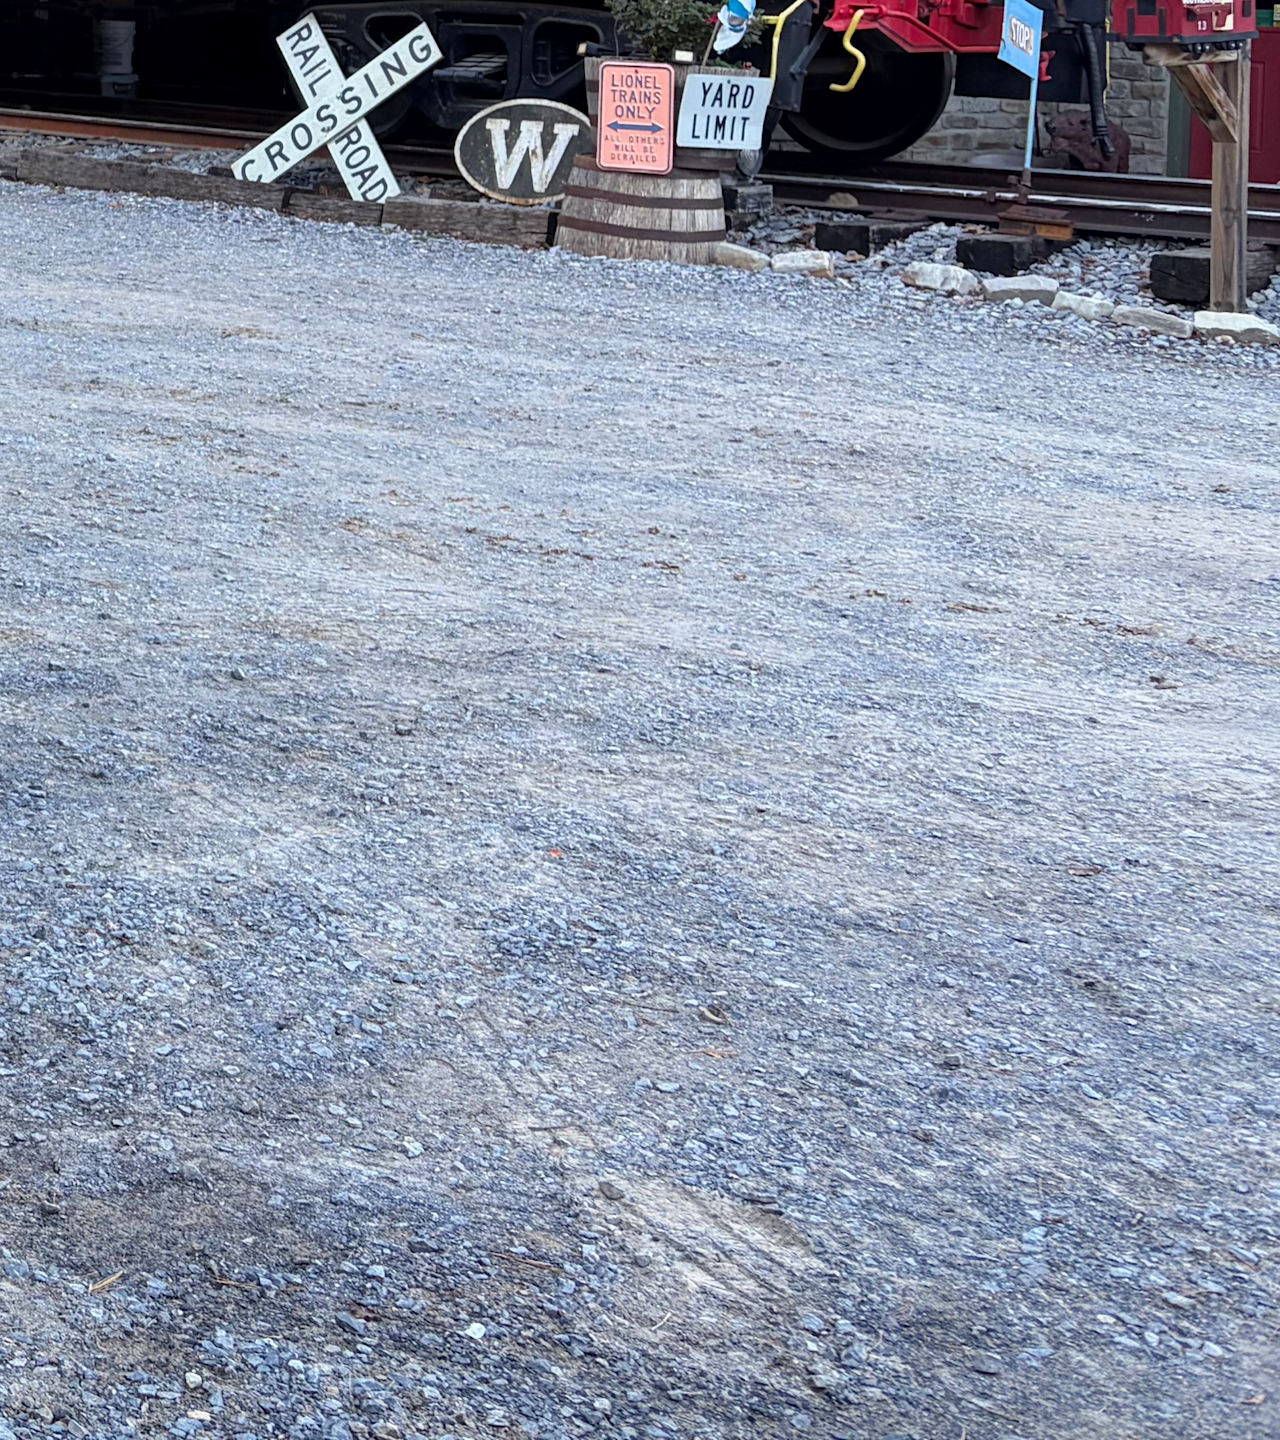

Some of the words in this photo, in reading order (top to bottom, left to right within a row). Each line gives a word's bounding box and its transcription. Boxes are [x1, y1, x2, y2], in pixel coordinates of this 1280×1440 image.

[1011, 17, 1030, 50] STOP
[1197, 20, 1207, 31] 13
[286, 22, 331, 97] RAIL
[611, 74, 662, 90] LIONEL
[610, 89, 661, 105] TRAINS
[701, 82, 754, 109] YARD
[241, 35, 432, 183] CROSSING
[614, 104, 656, 120] ONLY
[691, 114, 750, 142] LIMIT
[604, 134, 622, 143] ALL
[628, 135, 665, 145] OTHERS
[614, 144, 635, 153] WILL
[643, 146, 655, 154] BE
[335, 124, 388, 203] ROAD
[485, 118, 580, 193] W
[610, 153, 657, 164] DERAILED
